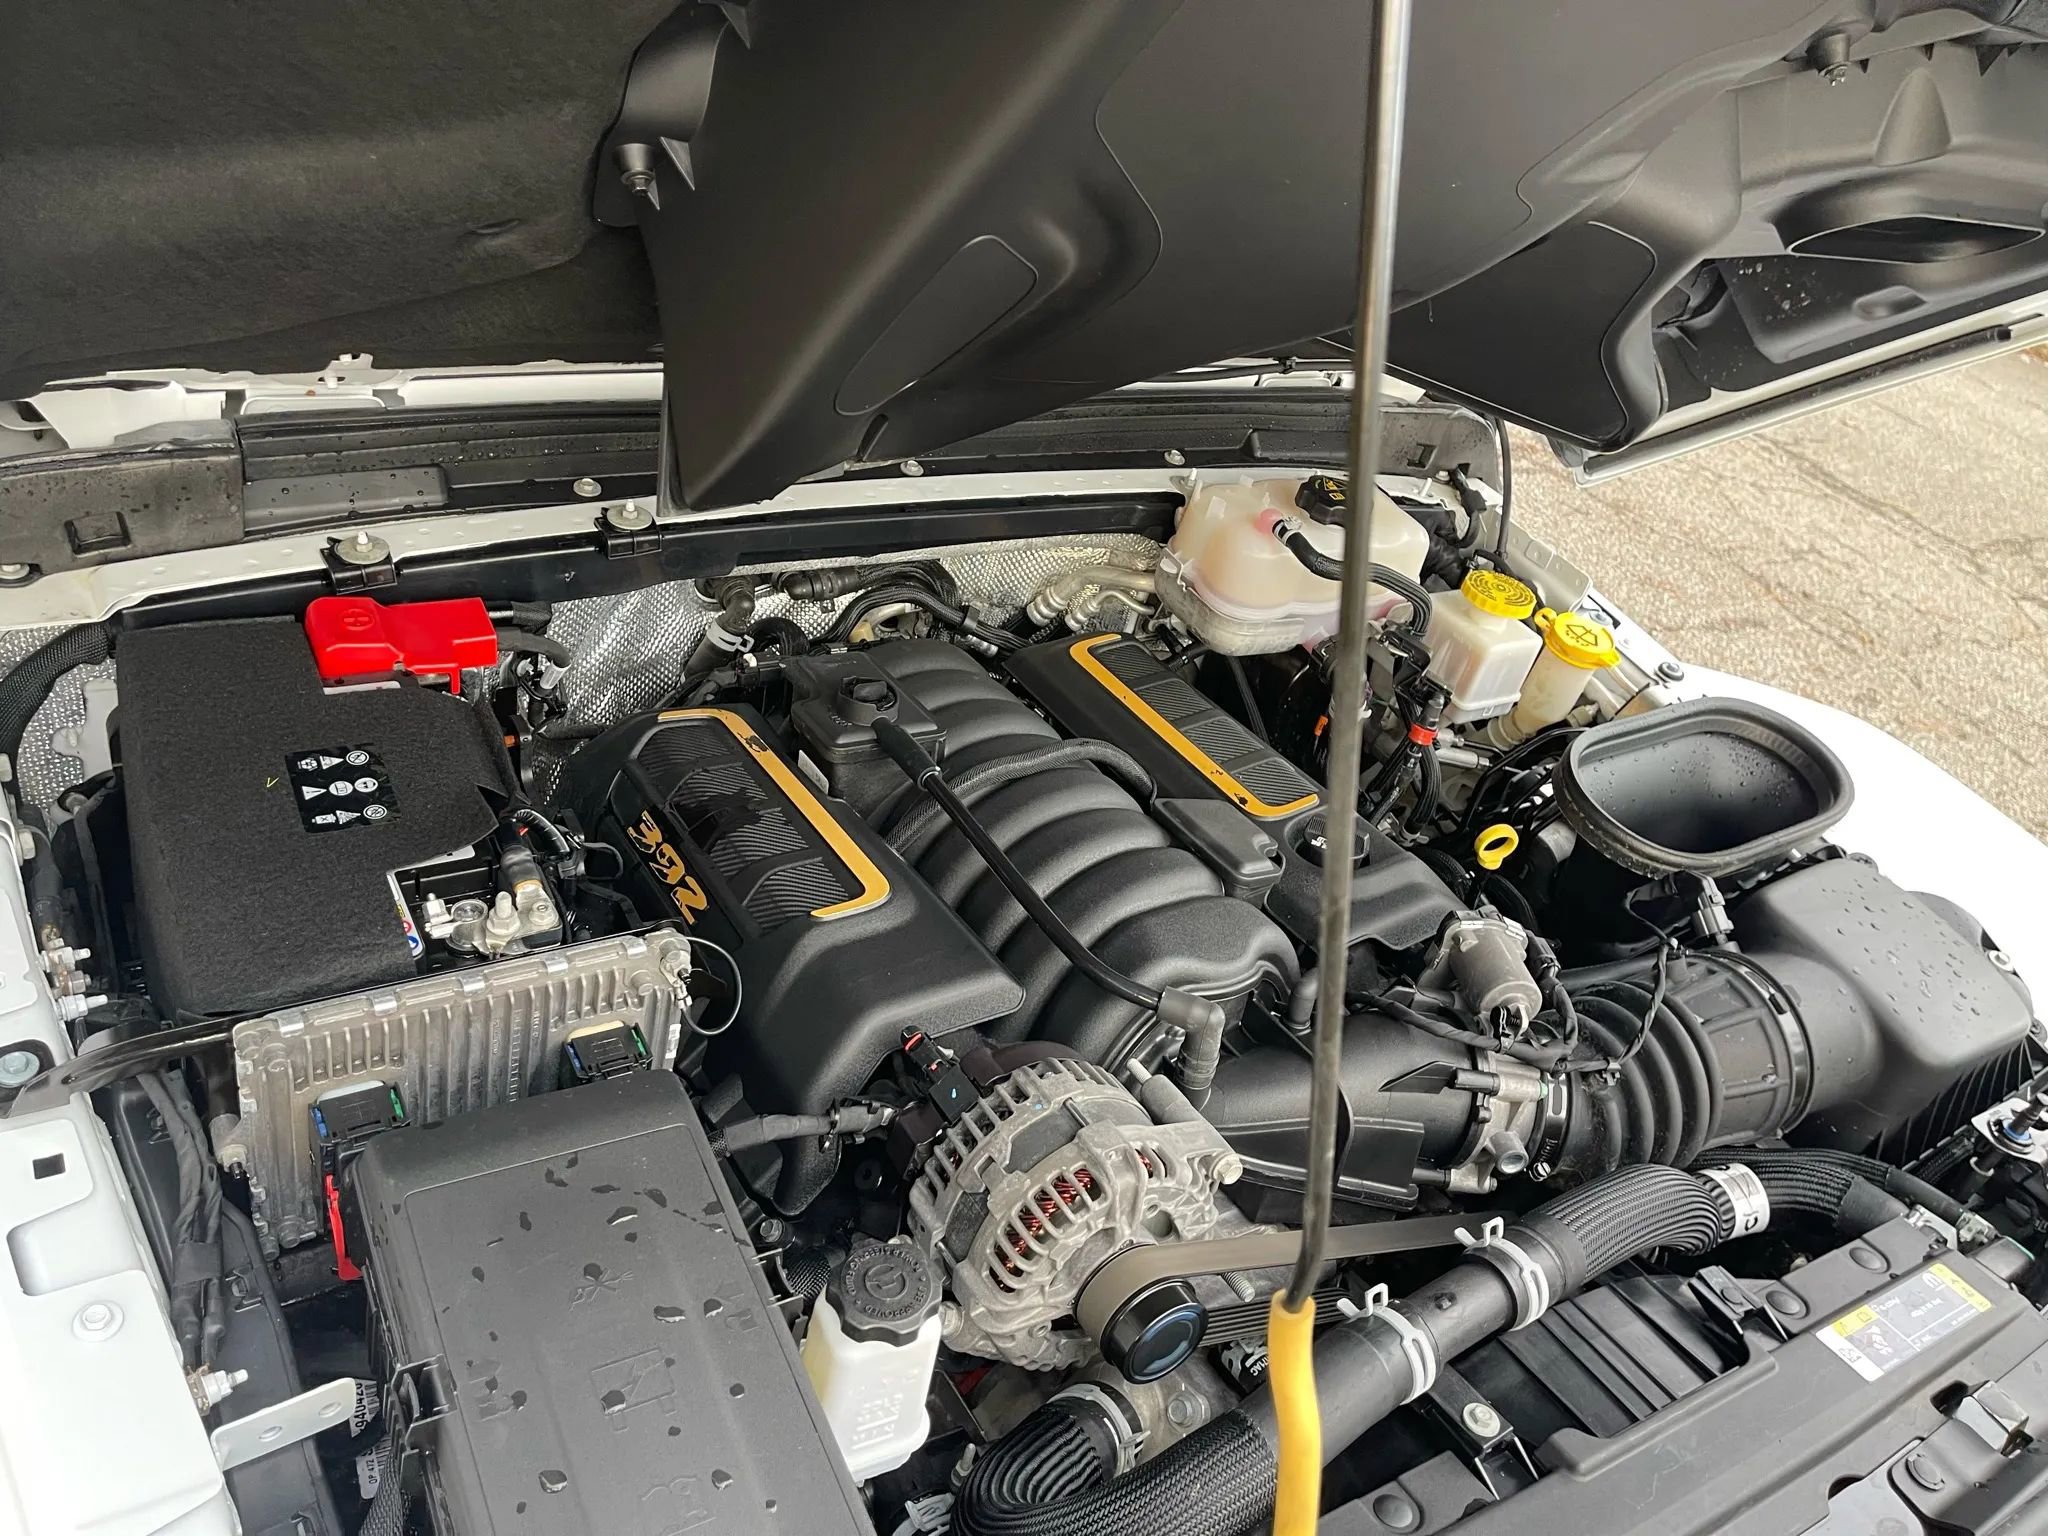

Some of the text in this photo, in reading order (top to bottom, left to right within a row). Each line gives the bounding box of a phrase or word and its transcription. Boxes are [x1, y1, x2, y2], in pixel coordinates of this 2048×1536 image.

[627, 810, 709, 925] 392
[845, 1247, 923, 1295] POWER STEERING FLUID
[865, 1286, 928, 1319] USE APPROVED
